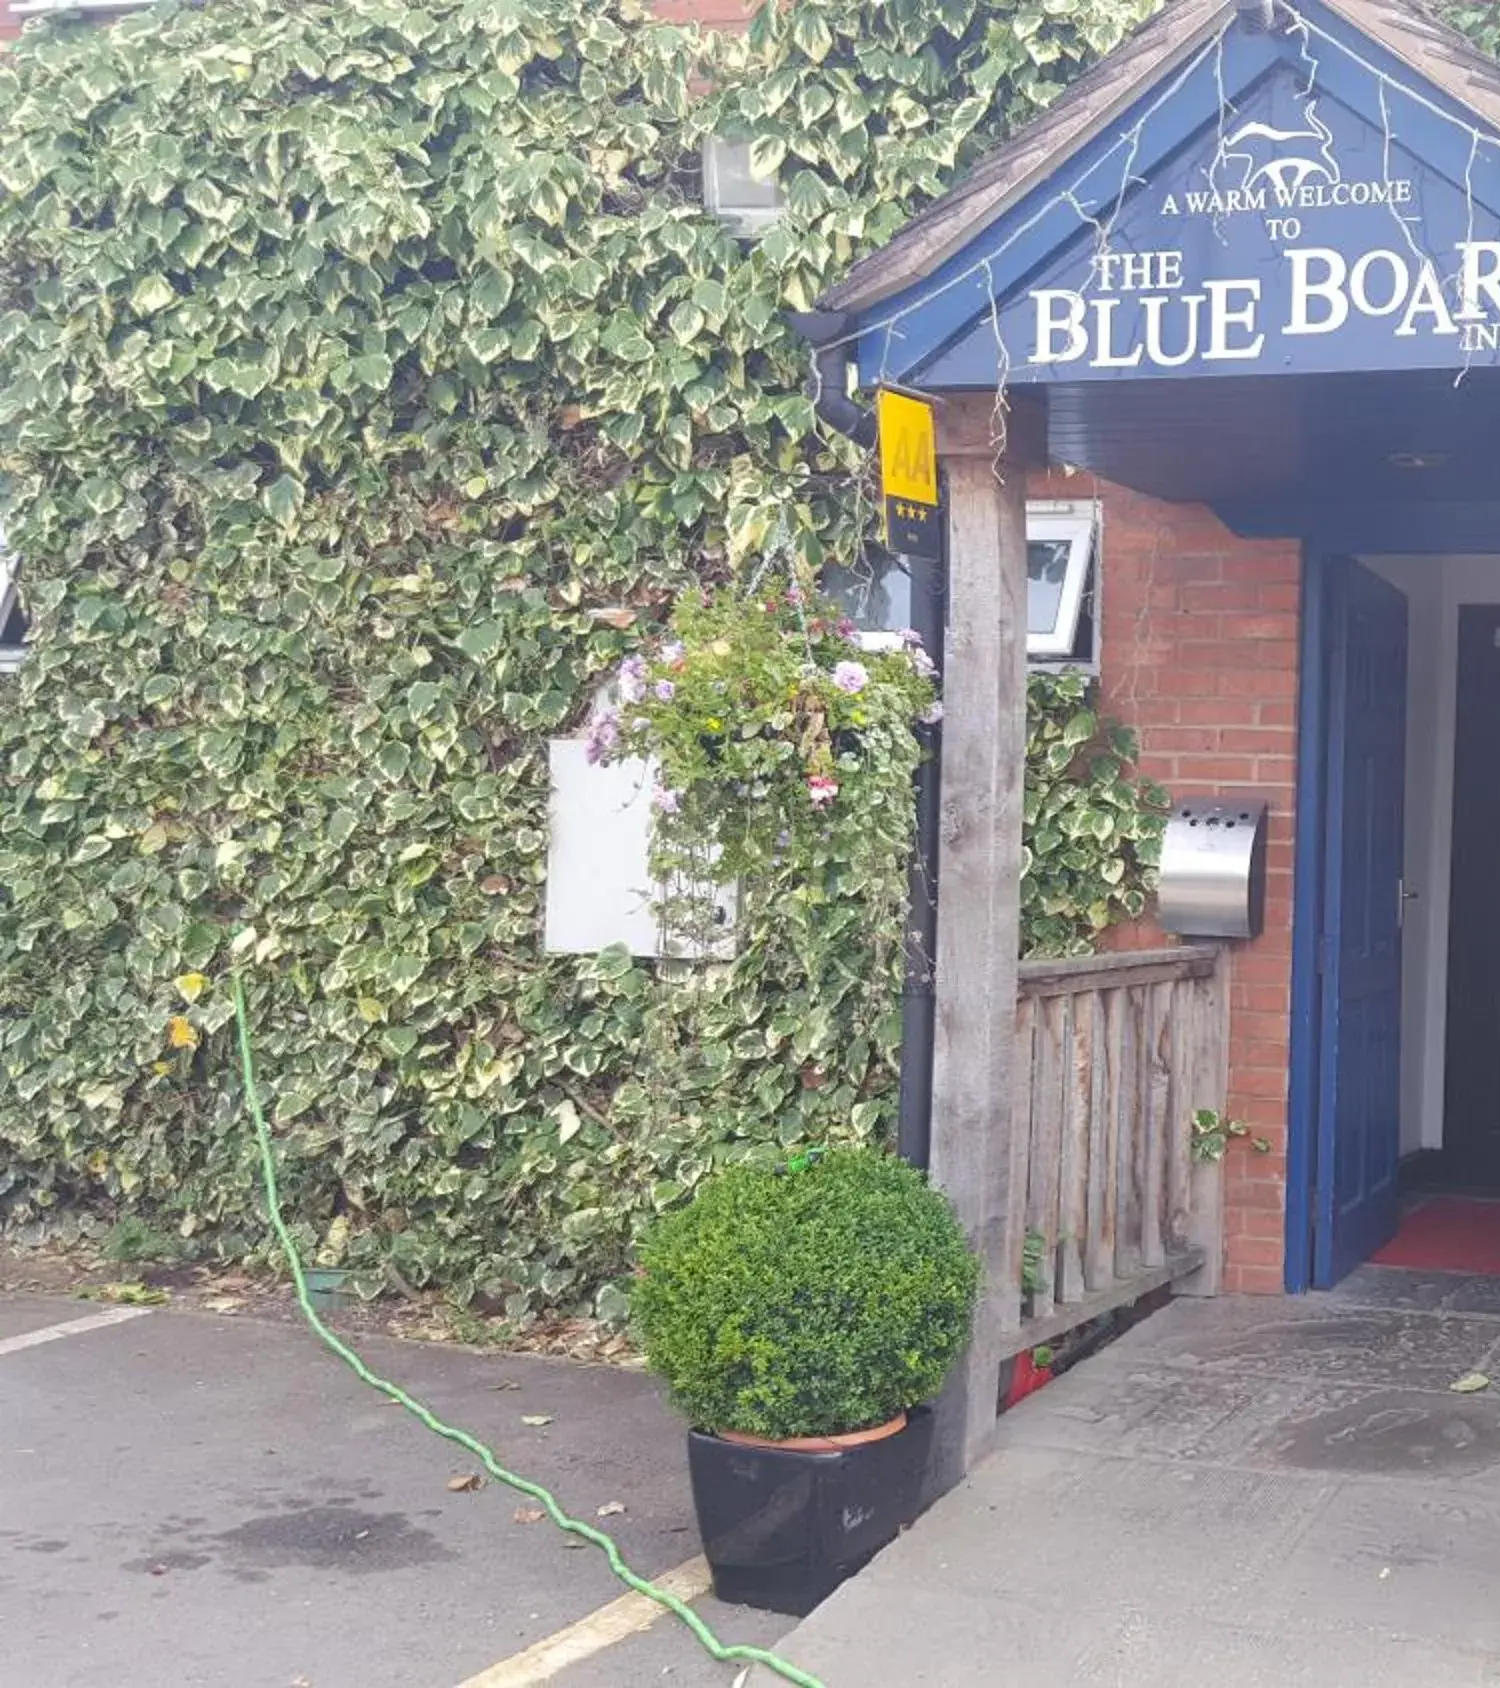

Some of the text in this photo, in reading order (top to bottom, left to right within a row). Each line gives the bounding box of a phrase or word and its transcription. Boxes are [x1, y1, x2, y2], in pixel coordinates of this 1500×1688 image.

[1161, 179, 1412, 215] A WARM WELCOME
[1266, 217, 1302, 240] TO
[1096, 251, 1184, 291] THE
[1028, 278, 1265, 368] BLUE
[891, 425, 932, 486] AA
